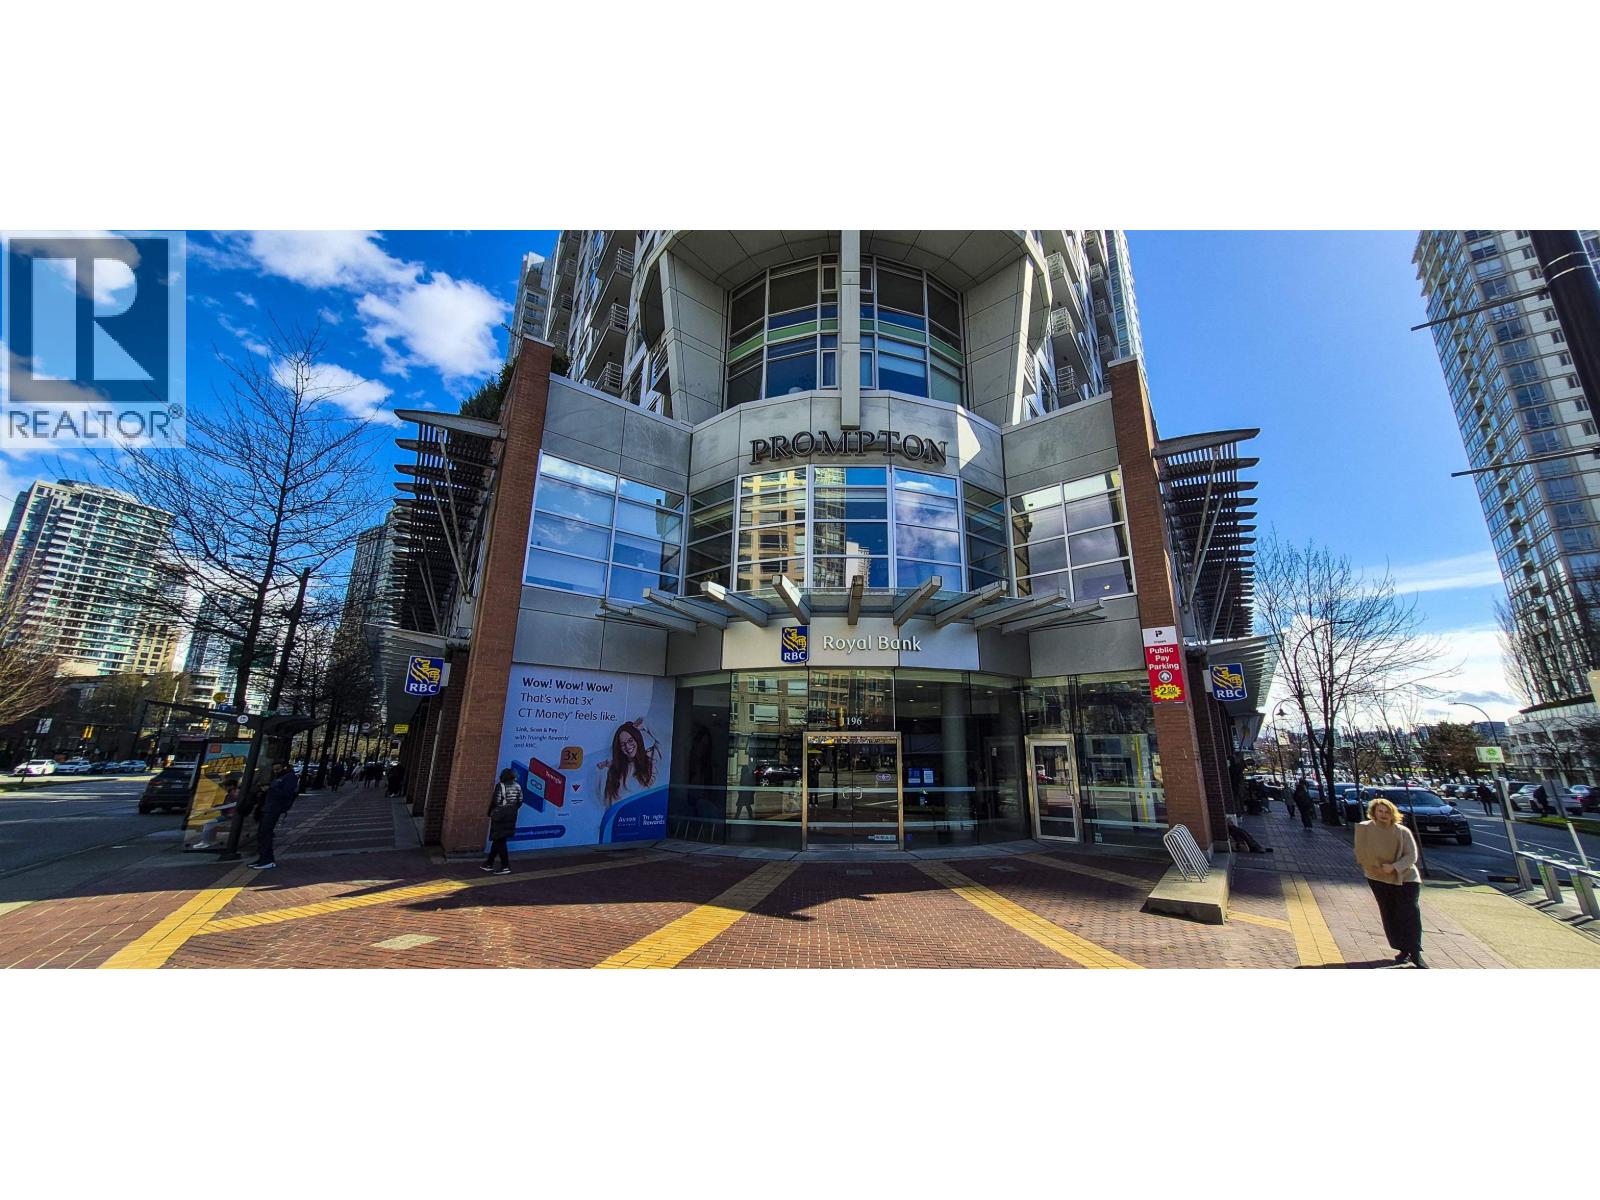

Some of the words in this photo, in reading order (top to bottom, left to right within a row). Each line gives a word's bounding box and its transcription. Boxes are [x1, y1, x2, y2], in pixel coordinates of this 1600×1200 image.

[748, 430, 949, 466] PROMPTON
[823, 635, 873, 654] Royal
[877, 636, 922, 651] Bank
[783, 651, 806, 660] RBC
[1148, 663, 1179, 671] Parking
[409, 683, 437, 693] RBC
[522, 677, 553, 689] Wow!
[555, 679, 584, 691] Wow!
[586, 682, 613, 693] Wow!
[520, 692, 551, 704] That's
[554, 694, 579, 705] what
[1216, 689, 1243, 698] RBC
[518, 707, 532, 718] CT
[574, 709, 597, 721] feels
[600, 711, 618, 722] like.
[847, 716, 863, 726] 196
